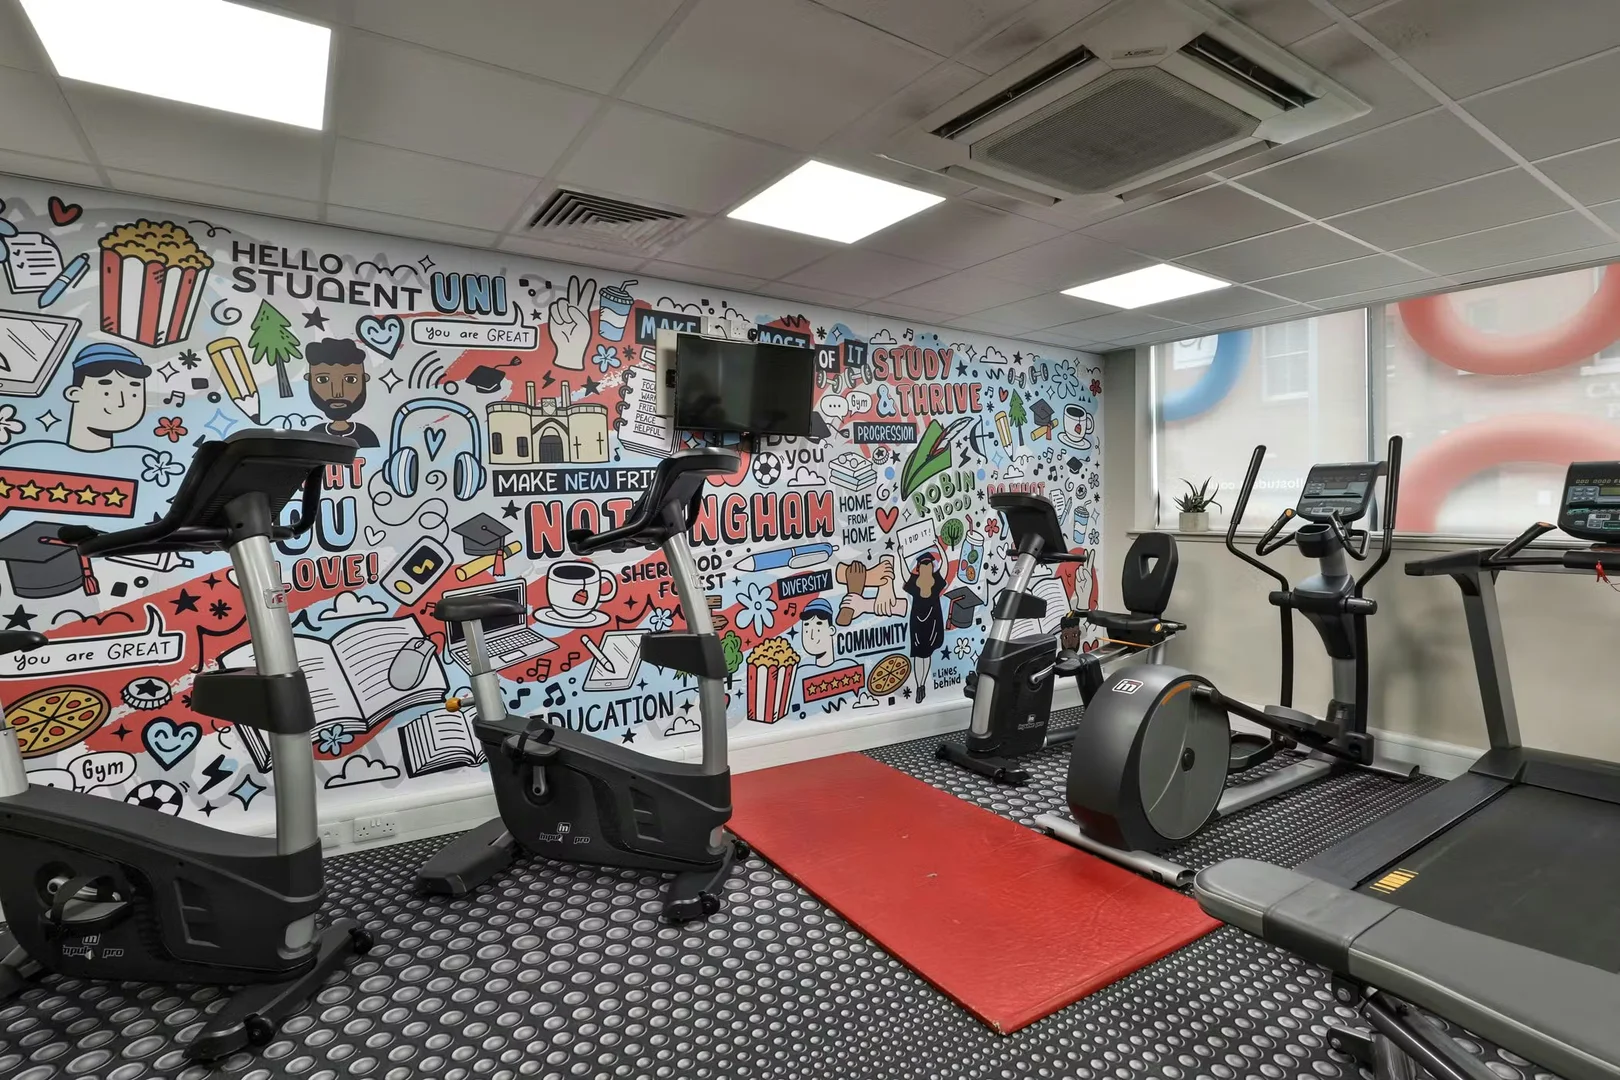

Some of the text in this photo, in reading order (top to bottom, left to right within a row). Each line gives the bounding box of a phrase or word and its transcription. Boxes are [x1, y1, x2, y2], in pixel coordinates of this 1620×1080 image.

[232, 240, 343, 275] HELLO
[232, 266, 422, 311] STUDENT
[430, 271, 508, 316] UNI
[425, 326, 530, 343] you are GREAT
[818, 349, 836, 369] OF
[847, 344, 864, 365] IT
[872, 347, 954, 382] STUDY
[850, 394, 868, 410] Gym
[876, 382, 983, 418] & THRIVE
[634, 423, 662, 437] HELPFUL
[635, 413, 657, 425] PEACE
[857, 424, 914, 441] PROGRESSION
[785, 448, 825, 471] you
[498, 469, 656, 493] MAKE NEW FRI
[839, 493, 874, 513] HOME
[911, 470, 976, 518] ROBIN
[847, 513, 869, 525] FROM
[932, 495, 972, 523] HOOD
[275, 496, 358, 555] OU
[524, 490, 835, 561] NOTNGHAM
[842, 525, 877, 545] HOME
[909, 533, 919, 544] DID
[921, 527, 932, 538] IT!
[620, 554, 723, 584] SHEROD
[781, 573, 829, 597] DIVERSITY
[836, 622, 908, 655] COMMUNITY
[14, 641, 171, 671] you are GREAT
[529, 690, 674, 733] DUCATION
[82, 759, 124, 783] Gym
[102, 948, 124, 958] pro
